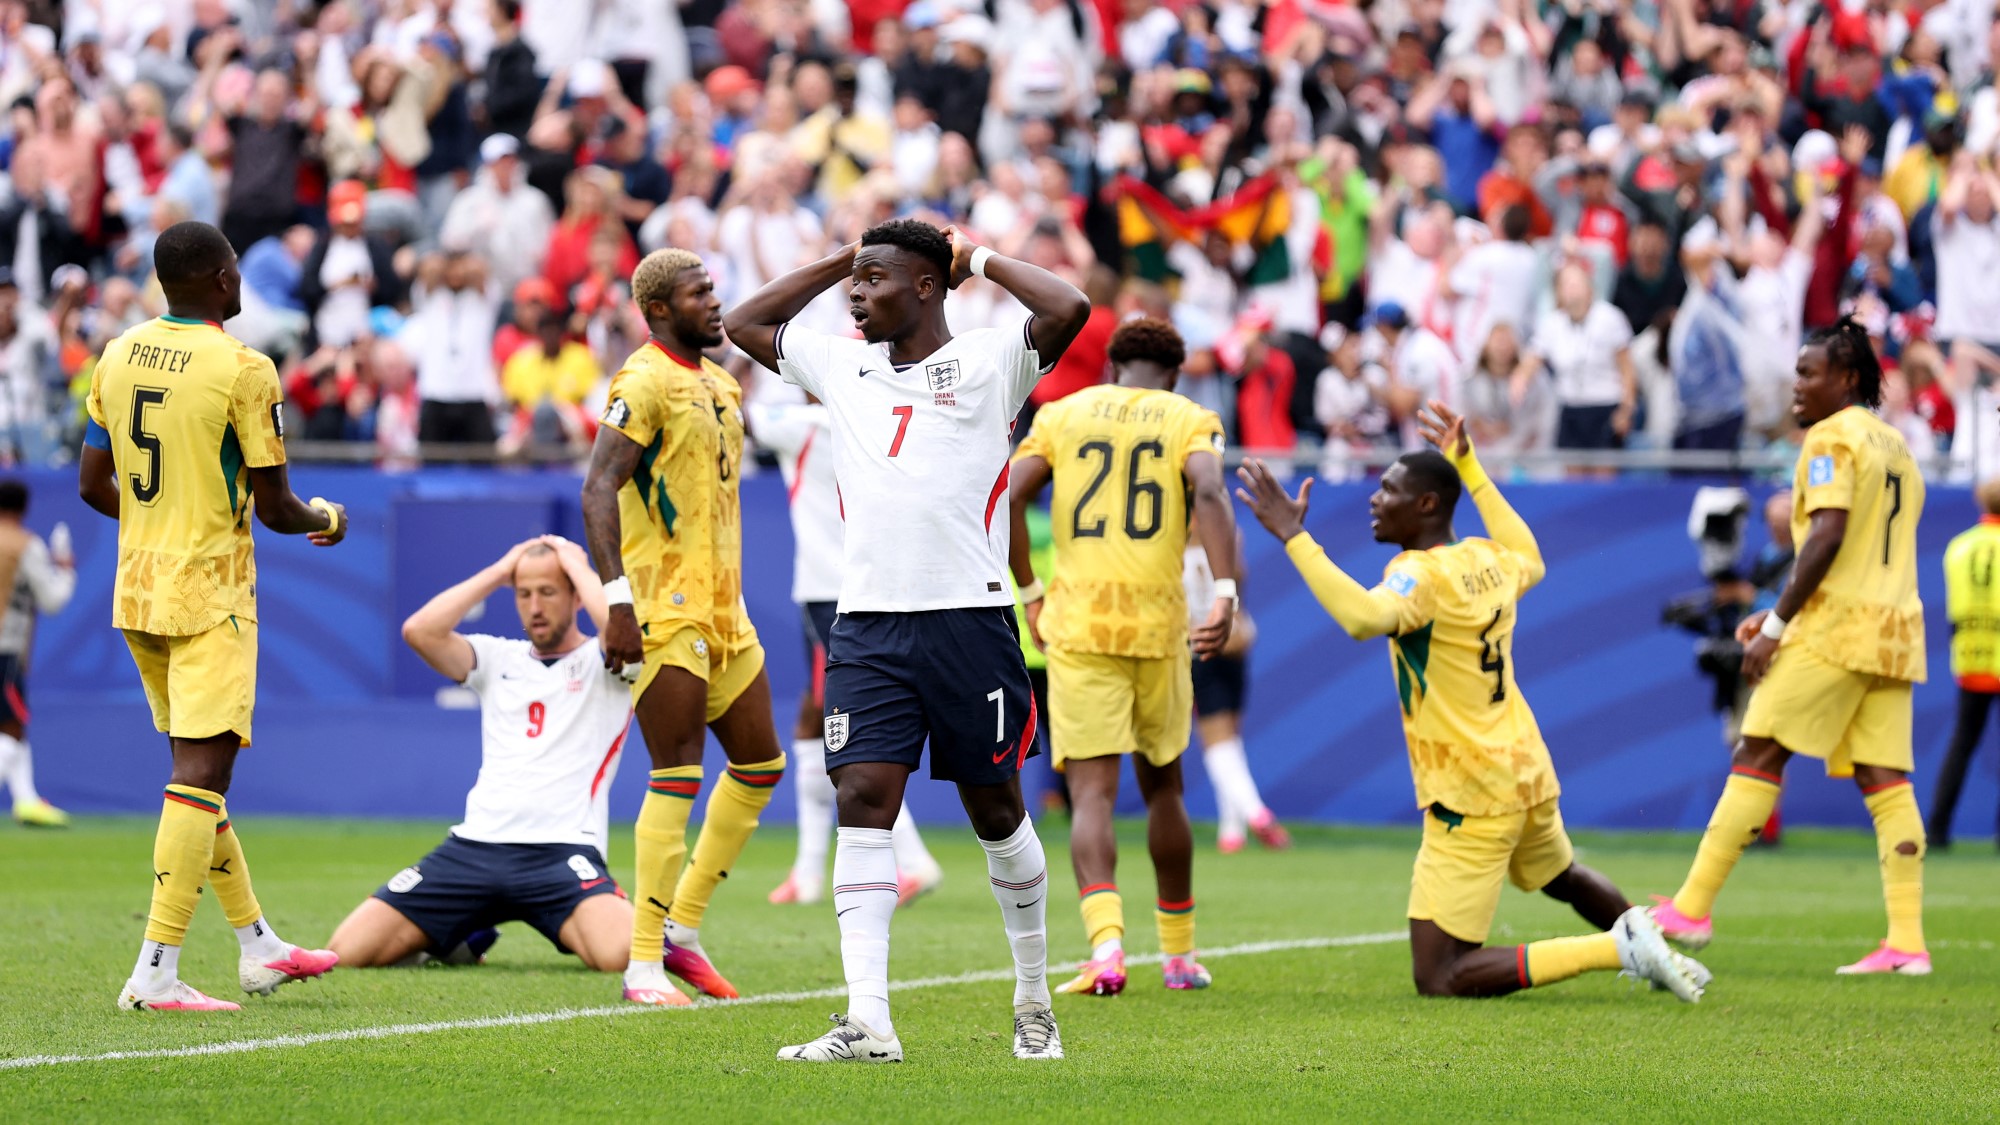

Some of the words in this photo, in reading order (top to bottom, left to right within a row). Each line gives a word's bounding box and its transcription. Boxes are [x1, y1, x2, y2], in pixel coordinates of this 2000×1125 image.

[128, 342, 192, 373] PARTEY
[129, 384, 172, 507] 5
[887, 405, 913, 457] 7
[1071, 434, 1168, 541] 26
[1883, 468, 1902, 566] 7
[1479, 604, 1505, 705] 4
[527, 701, 545, 738] 9
[987, 687, 1004, 743] 7
[567, 854, 599, 881] 9
